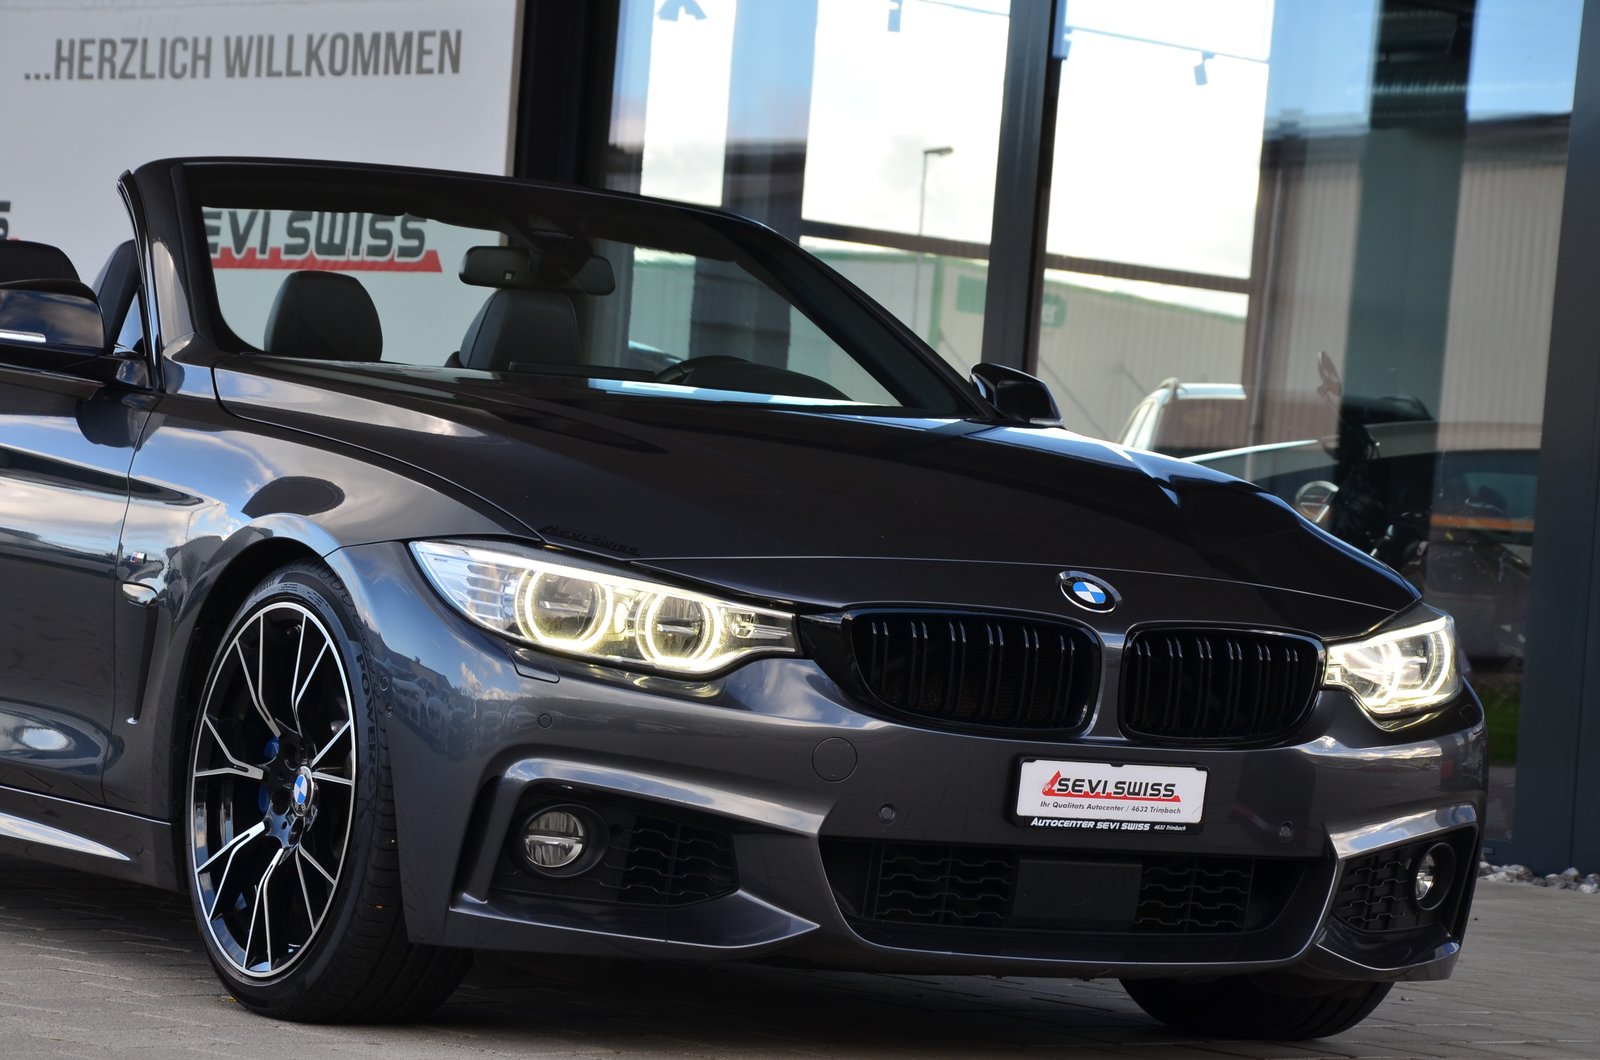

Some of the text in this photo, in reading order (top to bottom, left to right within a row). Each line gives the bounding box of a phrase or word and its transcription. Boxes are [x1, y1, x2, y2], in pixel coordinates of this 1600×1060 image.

[224, 30, 463, 78] WILLKOMMEN
[282, 209, 428, 259] SWISS
[1057, 777, 1176, 797] SEVI SWISS
[1086, 804, 1125, 812] Autocenter
[1150, 806, 1181, 815] Trimbach
[1031, 817, 1095, 828] AUTOCENTER
[1096, 822, 1120, 830] SEVI
[1121, 822, 1150, 830] SWISS
